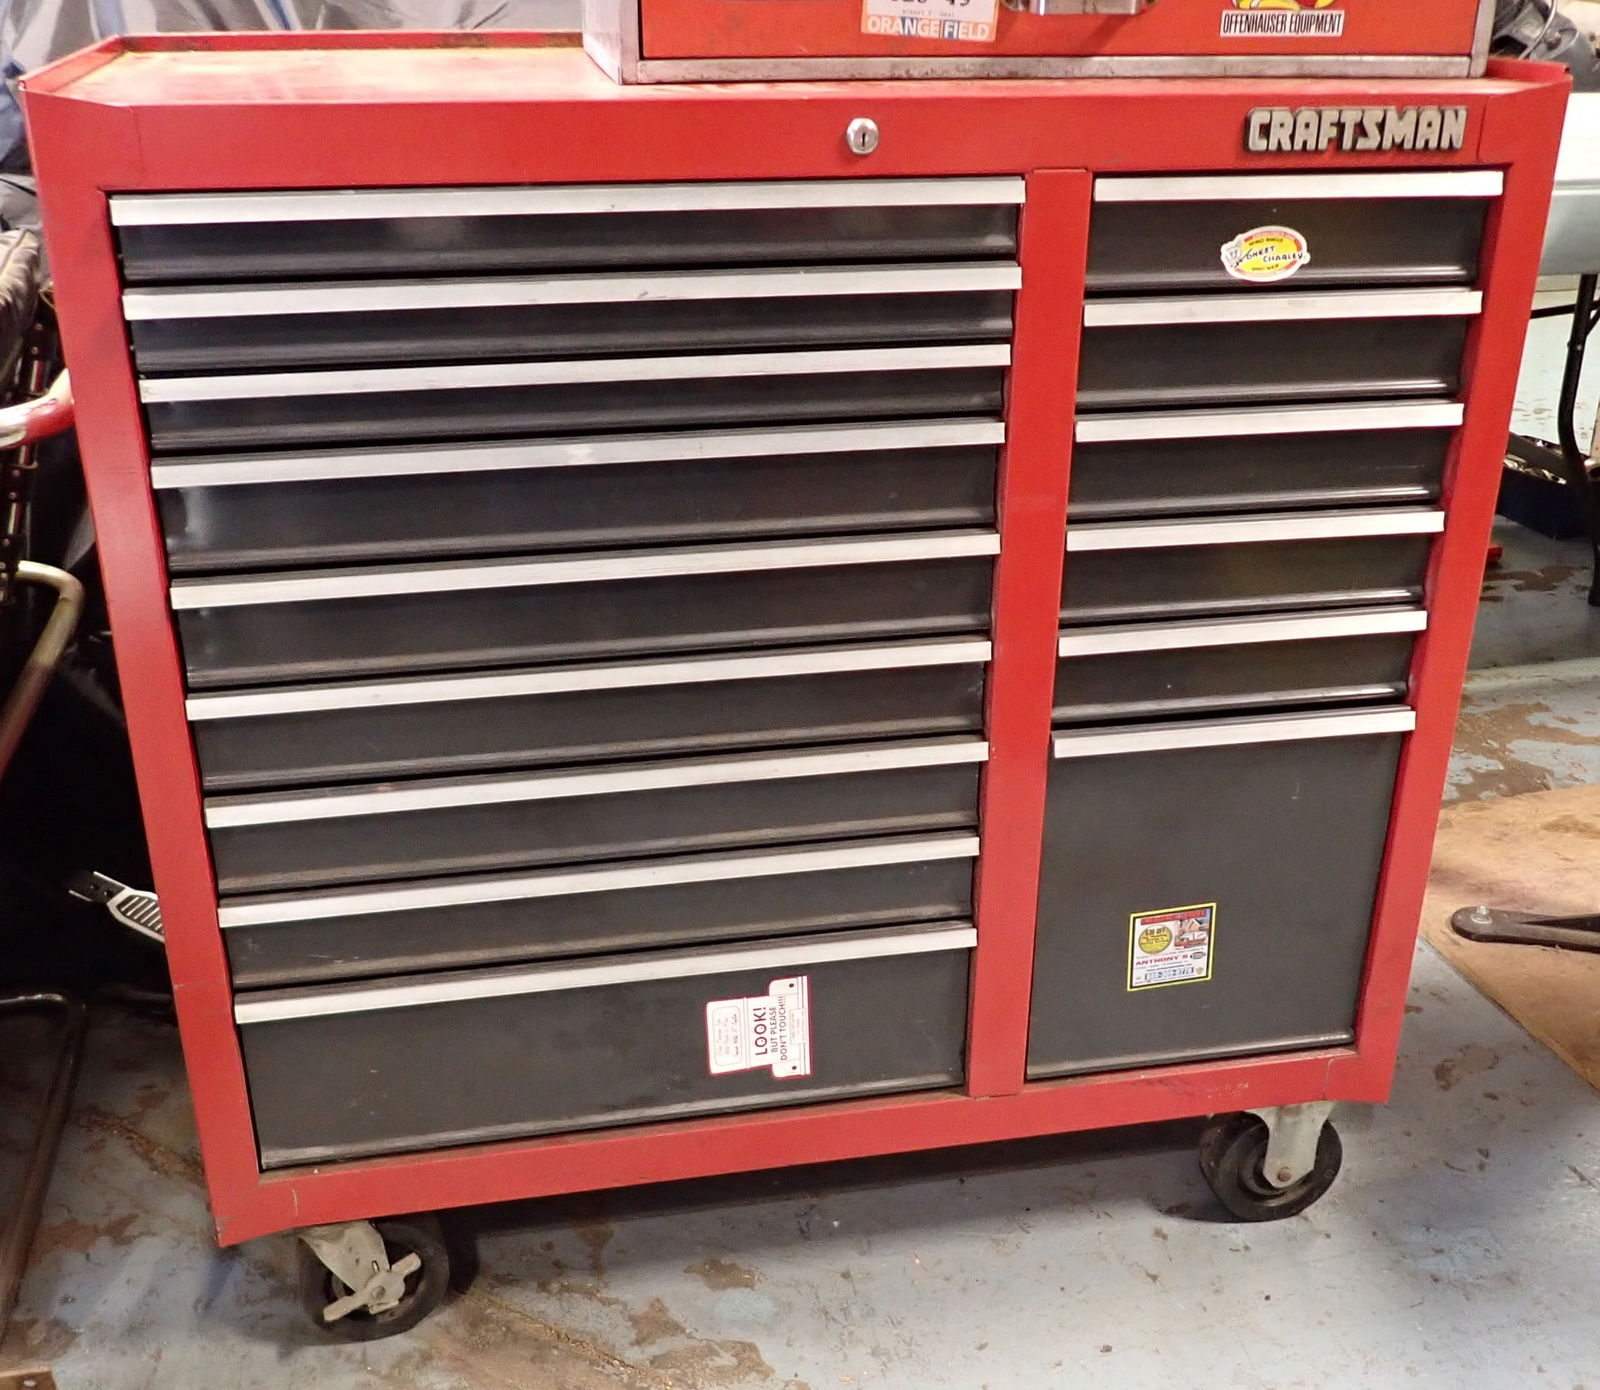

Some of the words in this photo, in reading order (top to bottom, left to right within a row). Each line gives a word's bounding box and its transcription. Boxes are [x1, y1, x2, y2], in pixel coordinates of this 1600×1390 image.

[867, 16, 940, 38] ORANGE
[943, 20, 990, 40] FIELD
[1223, 13, 1288, 34] OFFENHAUSER
[1289, 12, 1342, 34] EQUIPMENT
[1246, 106, 1468, 152] CRAFTSMAN
[753, 1007, 768, 1056] LOOK!
[769, 1006, 778, 1035] PLEASE
[770, 1038, 778, 1053] BUT
[779, 1034, 788, 1061] DON'T
